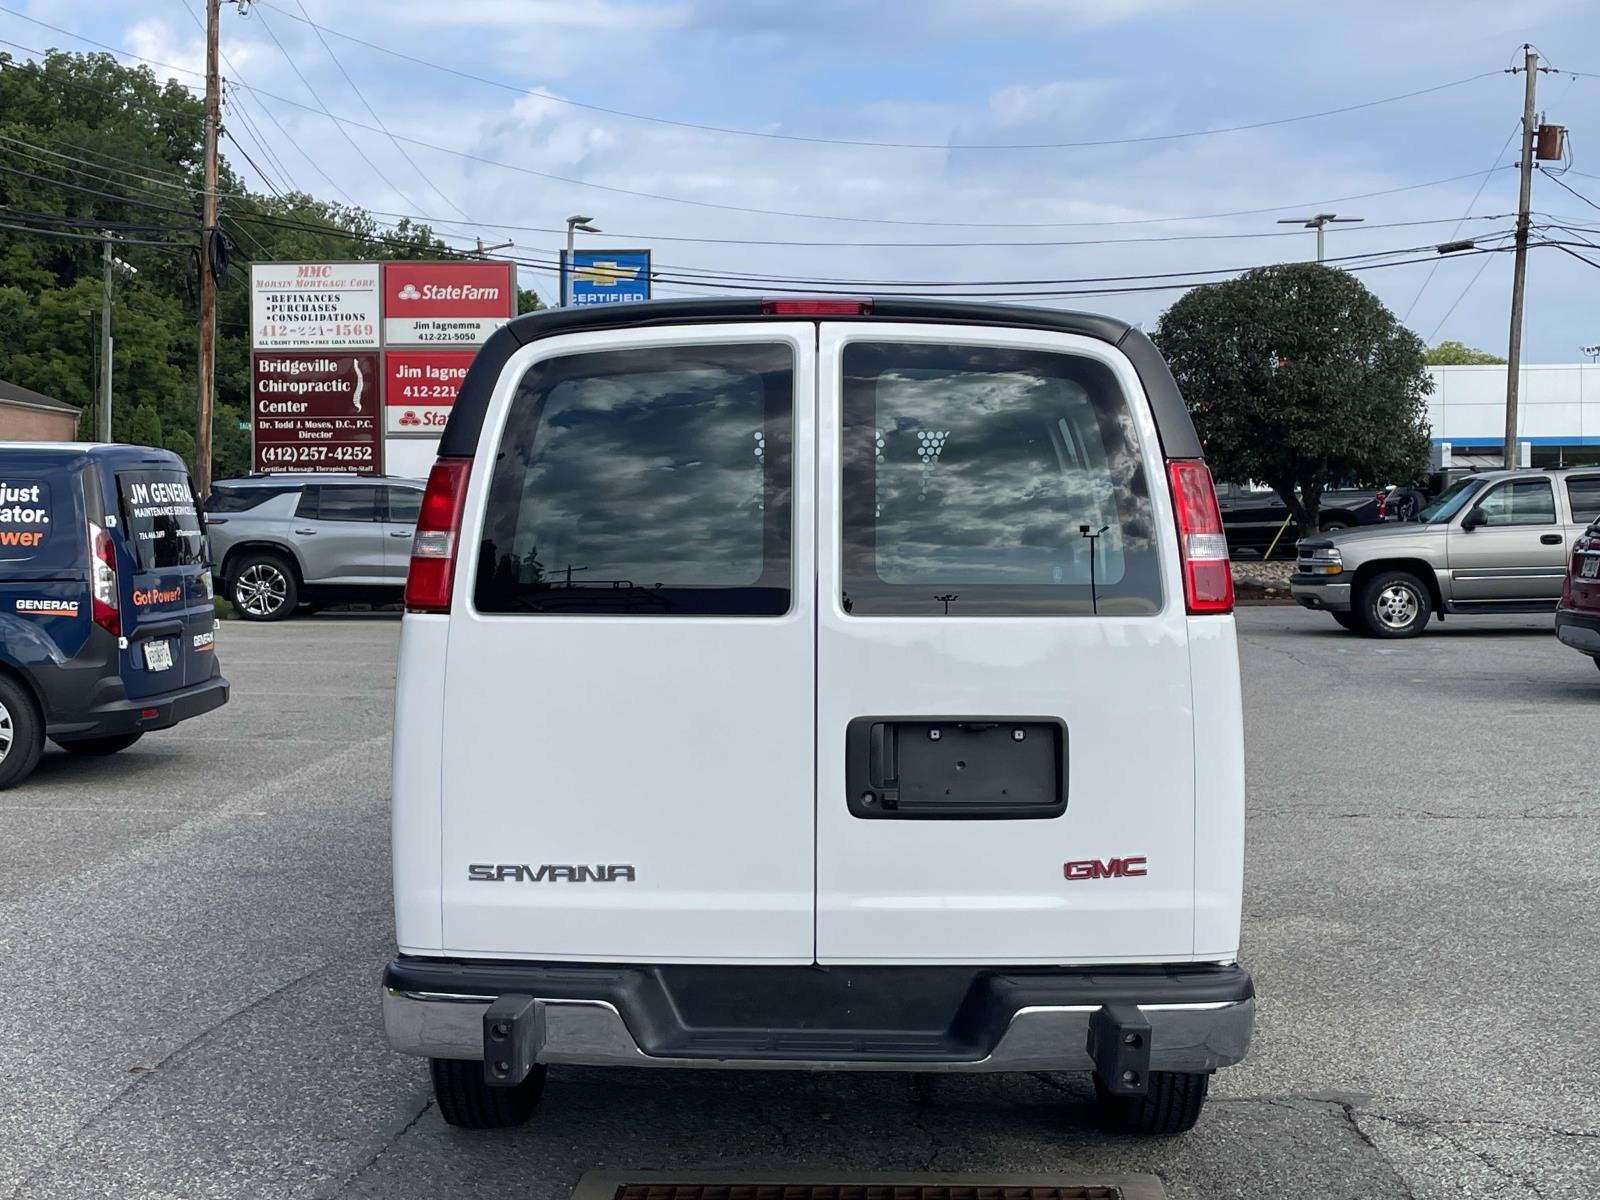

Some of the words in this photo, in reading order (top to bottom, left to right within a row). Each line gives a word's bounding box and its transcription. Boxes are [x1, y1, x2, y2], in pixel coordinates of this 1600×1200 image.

[297, 266, 332, 278] MMC
[295, 279, 346, 288] MORTGAGE
[272, 294, 341, 303] REFINANCES
[272, 303, 337, 312] PURCHASES
[272, 313, 366, 322] CONSOLIDATIONS
[260, 324, 373, 337] 412-221-1569
[413, 321, 430, 330] Jim
[432, 321, 481, 331] Iagnemma
[418, 333, 476, 341] 412-221-5050
[259, 359, 338, 375] Bridgeville
[396, 365, 422, 378] Jim
[426, 365, 469, 381] Iagne
[259, 379, 351, 395] Chiropractic
[403, 386, 459, 397] 412-221-
[259, 400, 308, 413] Center
[260, 421, 273, 429] Dr.
[274, 420, 294, 429] Todd
[296, 420, 303, 429] J.
[304, 420, 334, 429] Moses,
[357, 420, 373, 428] P.C.
[423, 411, 449, 426] Sta
[298, 430, 333, 439] Director
[261, 446, 298, 463] (412)
[299, 446, 373, 461] 257-4252
[316, 465, 347, 473] Therapists
[130, 483, 150, 505] JM
[0, 505, 50, 523] ator.
[134, 506, 174, 518] MAINTENANCE
[133, 590, 152, 606] Got
[152, 586, 182, 604] Power?
[16, 600, 79, 611] GENERAC
[467, 864, 636, 882] SAVANA
[1063, 856, 1148, 881] GMC
